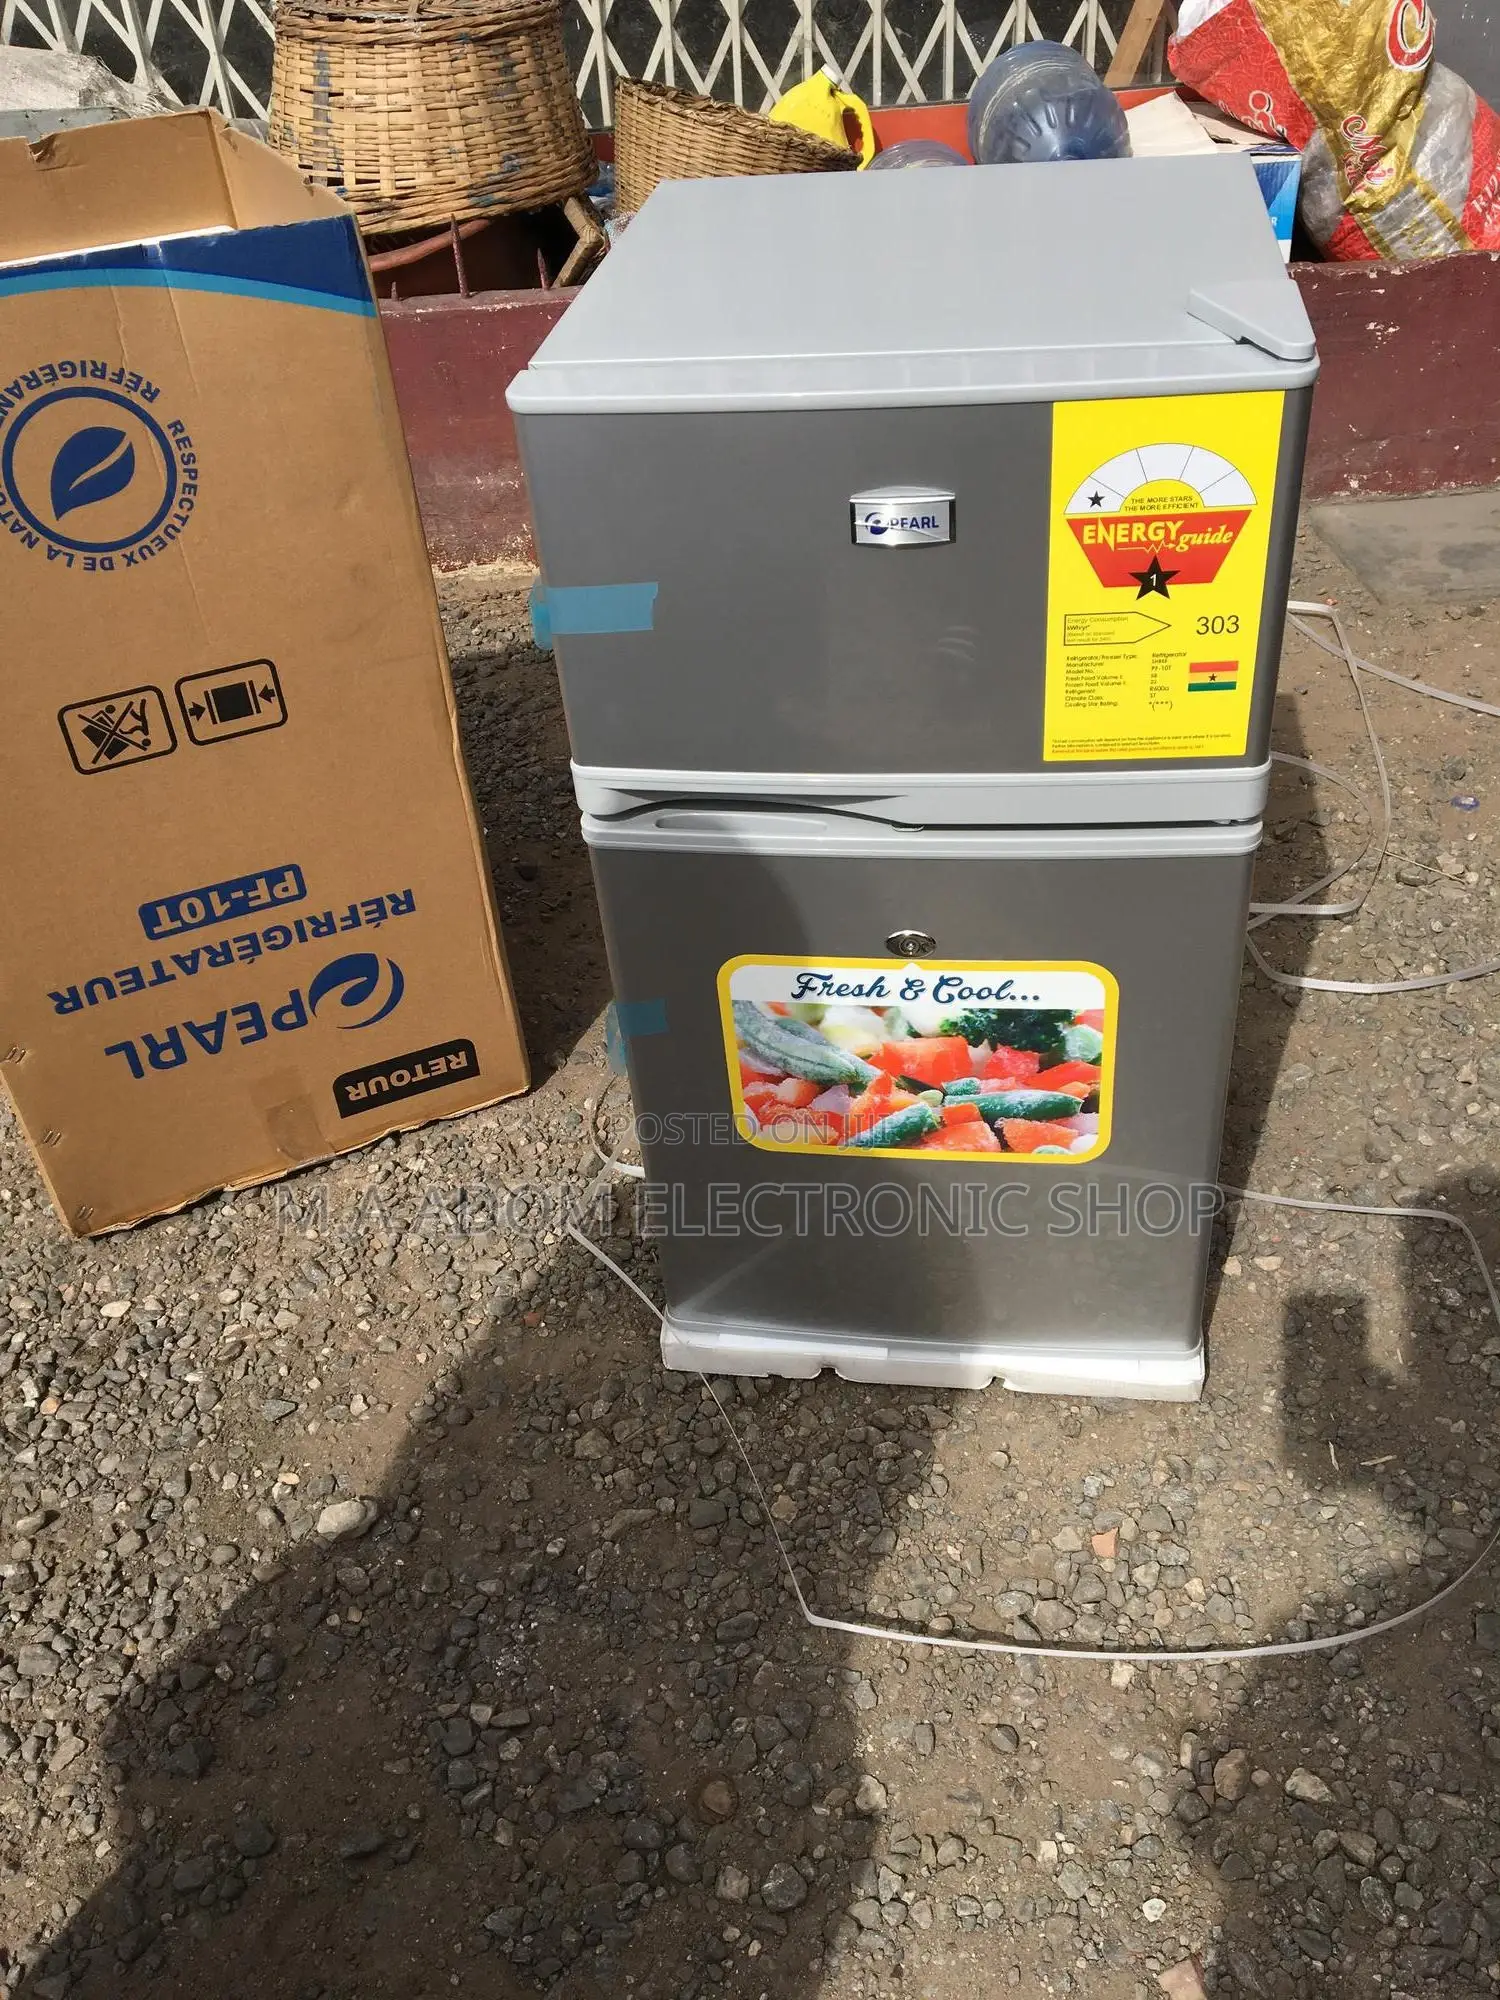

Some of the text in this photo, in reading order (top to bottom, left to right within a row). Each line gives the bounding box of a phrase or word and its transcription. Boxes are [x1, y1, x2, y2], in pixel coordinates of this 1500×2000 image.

[0, 360, 161, 428] RÉFRIGÉRAN
[121, 419, 199, 568] RESPECTUEUX
[1147, 496, 1168, 504] MORE
[1163, 502, 1198, 510] EFFICIENT
[1082, 517, 1234, 553] ENERGY guide
[46, 545, 75, 568] LA
[83, 556, 115, 571] DE
[1149, 573, 1157, 588] 1
[1196, 614, 1240, 636] 303
[151, 869, 301, 935] PF-10T
[47, 887, 417, 1016] RÉFRIGÉRATEUR
[790, 972, 890, 1001] Fresh
[899, 977, 926, 1001] &
[104, 987, 310, 1080] PEARL
[345, 1049, 469, 1104] RETOUR
